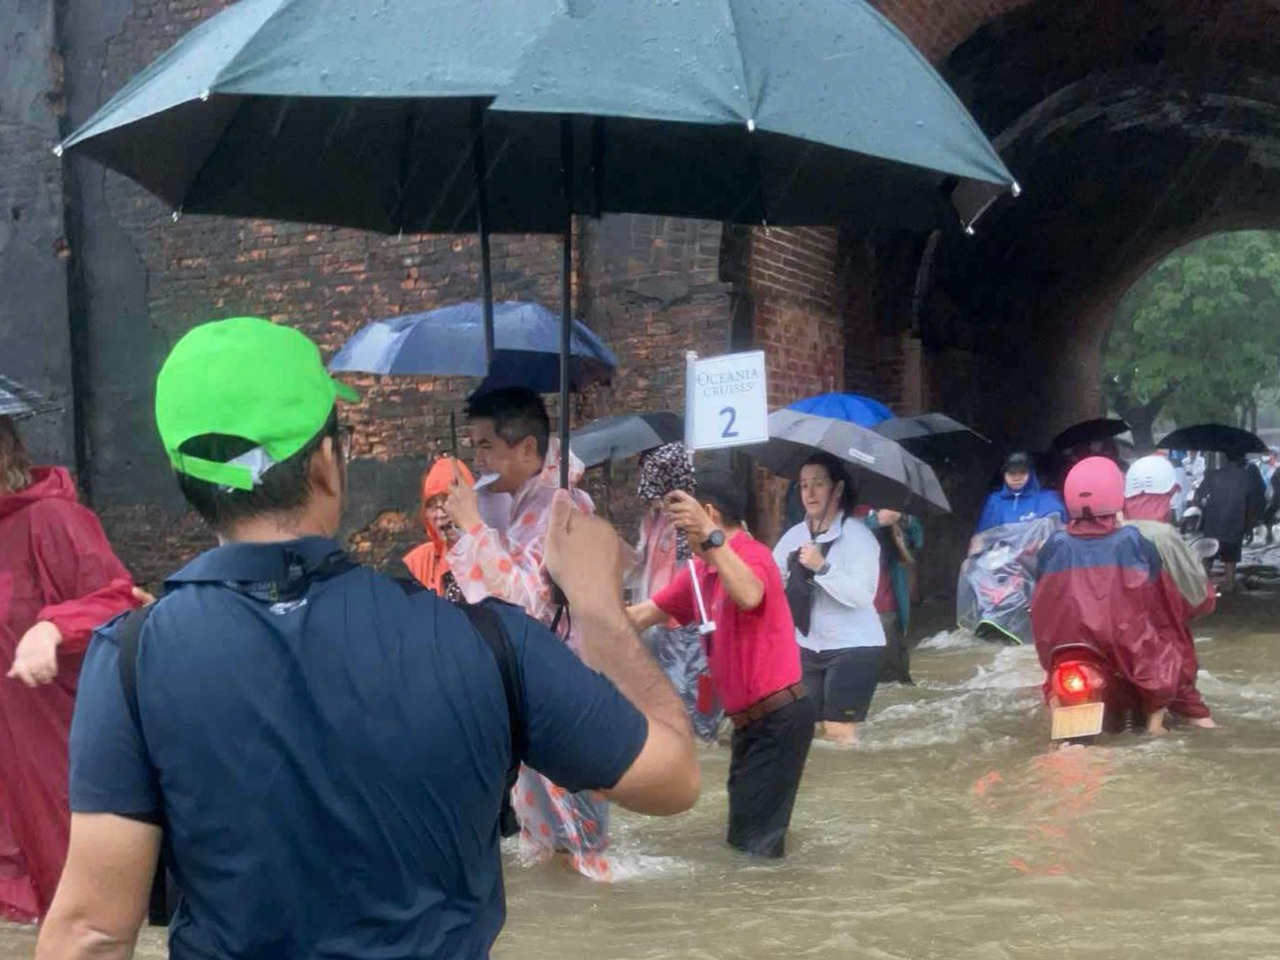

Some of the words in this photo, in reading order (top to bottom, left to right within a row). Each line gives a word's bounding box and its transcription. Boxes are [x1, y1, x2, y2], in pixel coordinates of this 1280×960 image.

[697, 368, 759, 386] OCEANIA
[703, 381, 753, 397] CRUISES
[719, 406, 739, 438] 2
